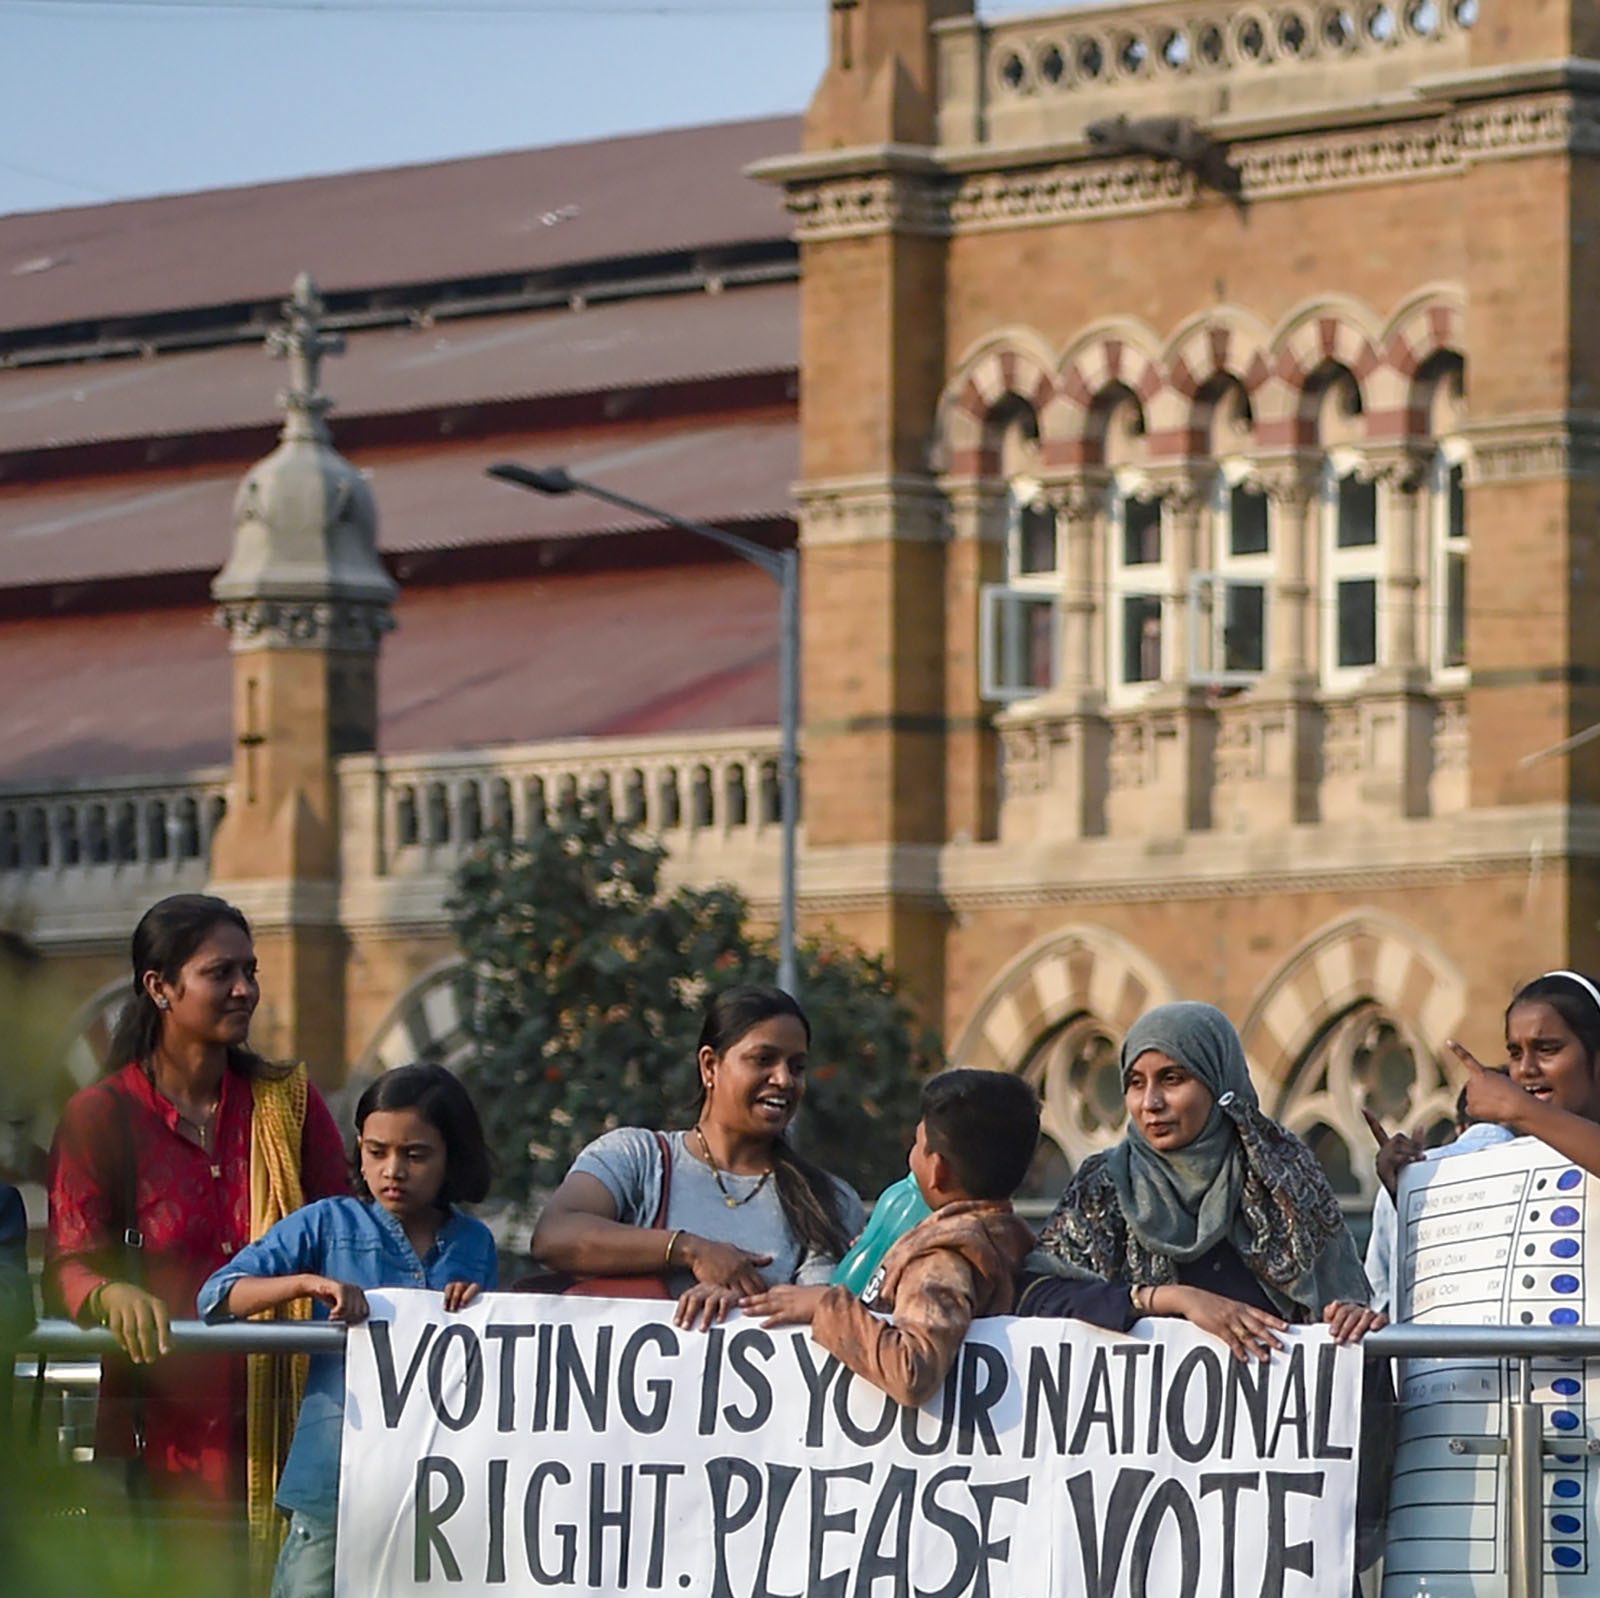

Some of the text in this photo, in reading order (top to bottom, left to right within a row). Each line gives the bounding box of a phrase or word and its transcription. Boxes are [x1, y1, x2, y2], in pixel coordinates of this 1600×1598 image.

[368, 1322, 675, 1435] VOTING
[698, 1327, 776, 1436] IS
[1022, 1341, 1353, 1463] NATIONAL
[414, 1456, 691, 1589] RIGHT.
